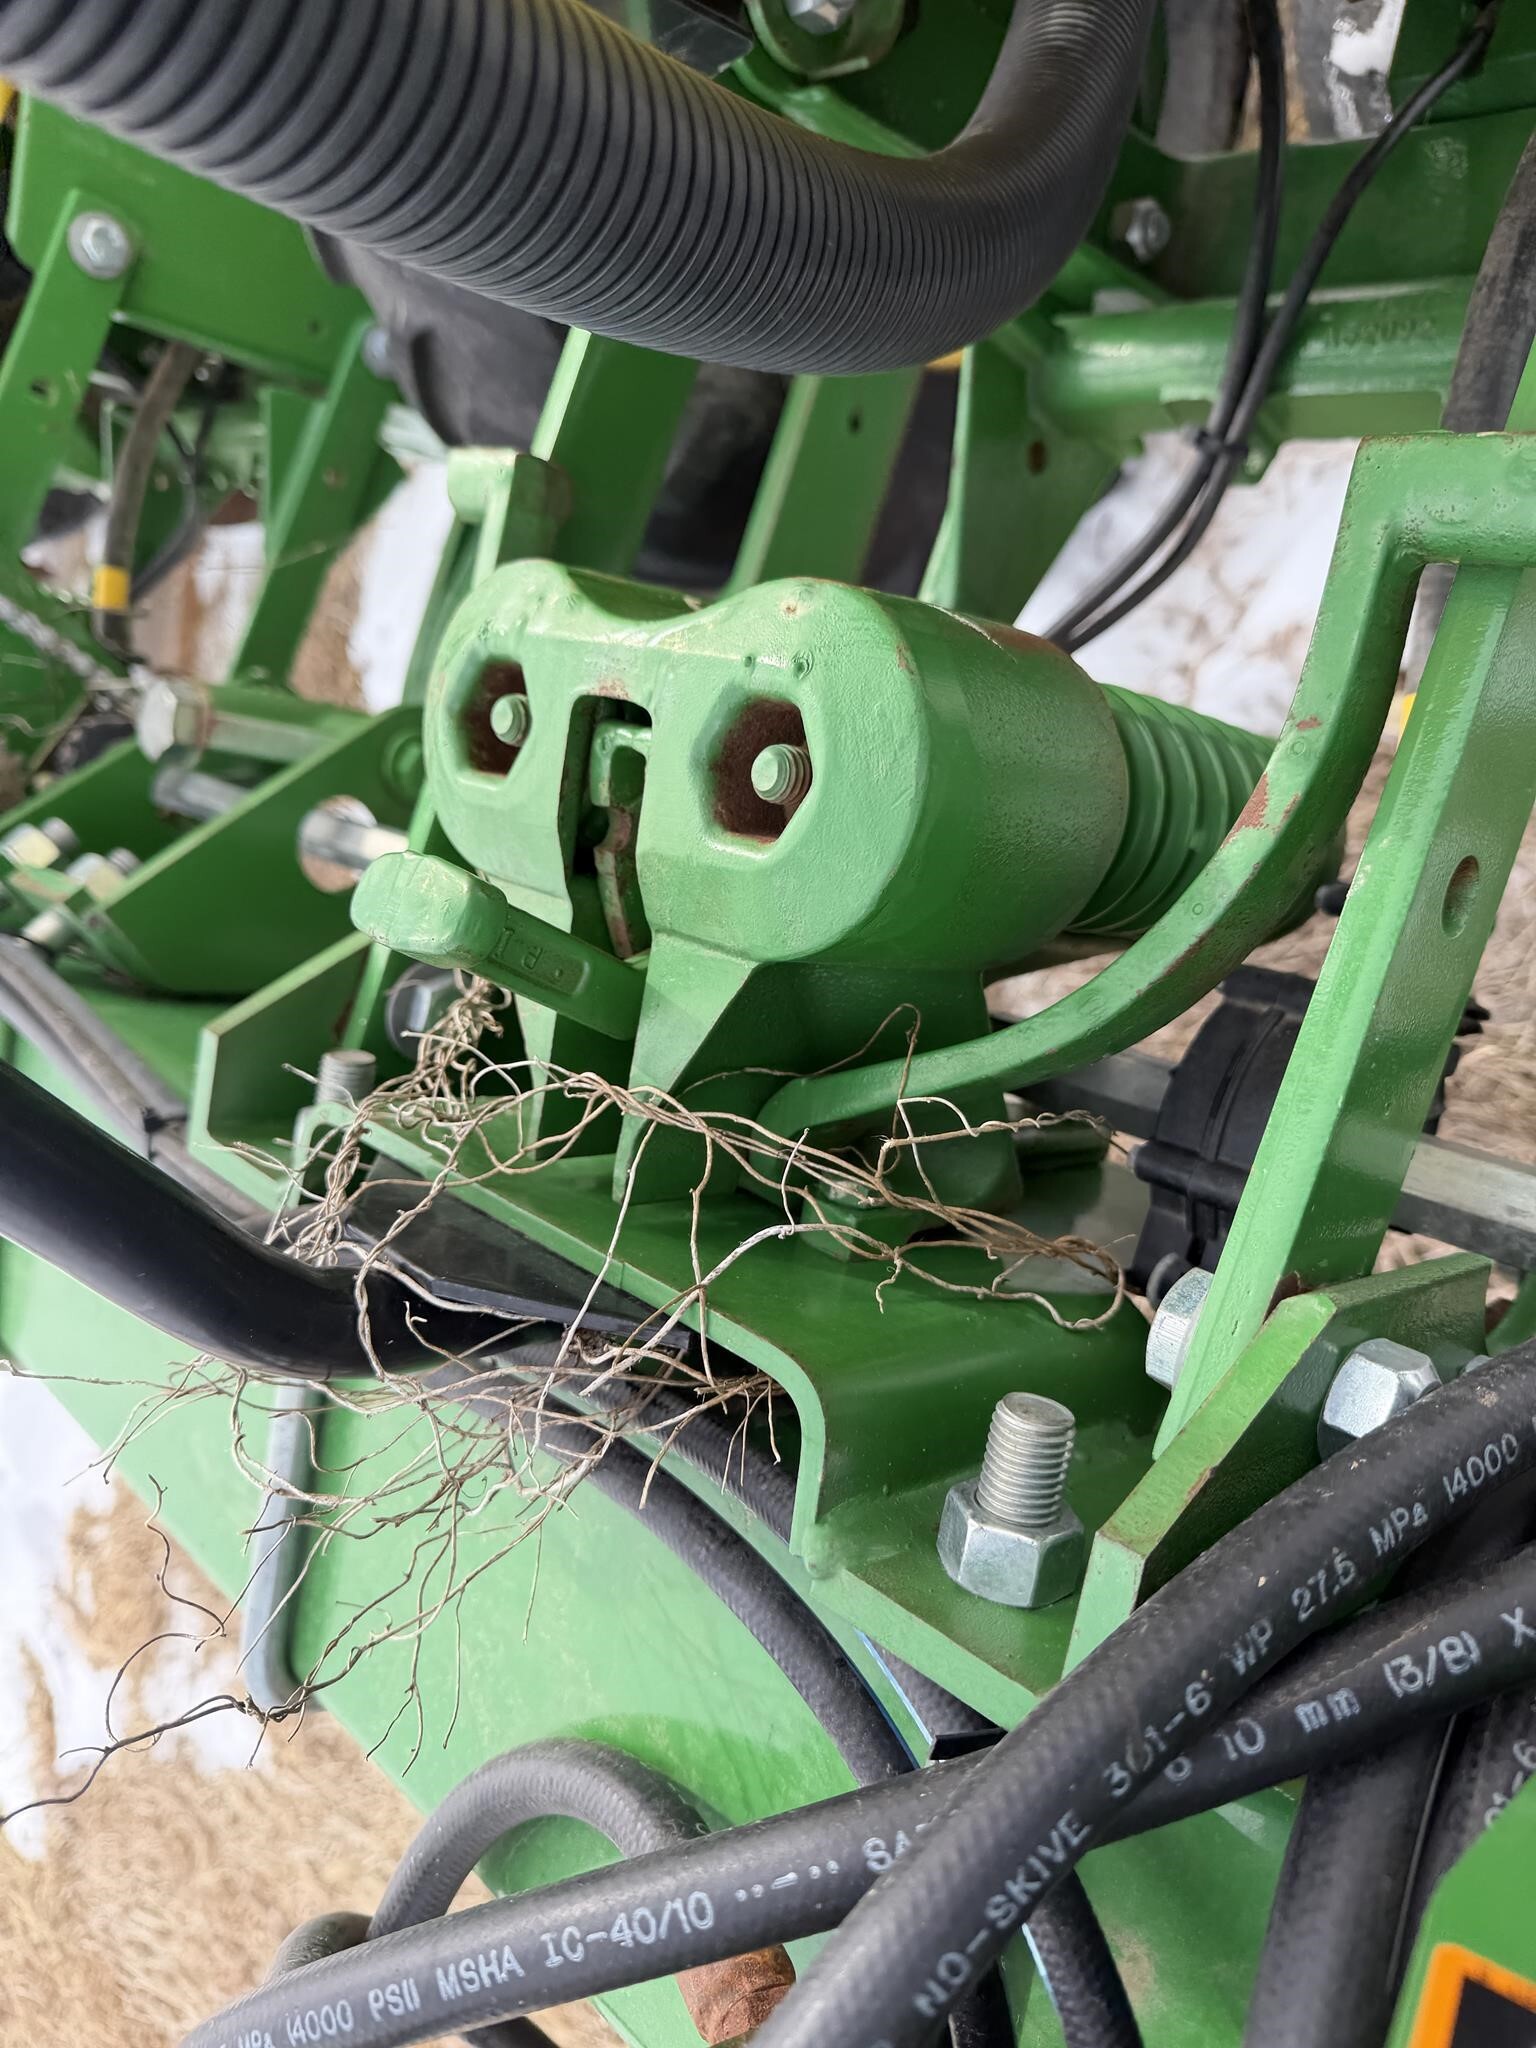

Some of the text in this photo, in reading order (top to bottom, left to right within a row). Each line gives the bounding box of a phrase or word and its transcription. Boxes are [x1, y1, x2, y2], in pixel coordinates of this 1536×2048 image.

[436, 1945, 525, 2001] MSHA
[1214, 1717, 1267, 1761] 10
[1294, 1687, 1361, 1733] mm
[913, 1809, 1092, 2017] NO-SKIVE
[1291, 1550, 1357, 1623] 27.5
[1368, 1502, 1428, 1557] MPa
